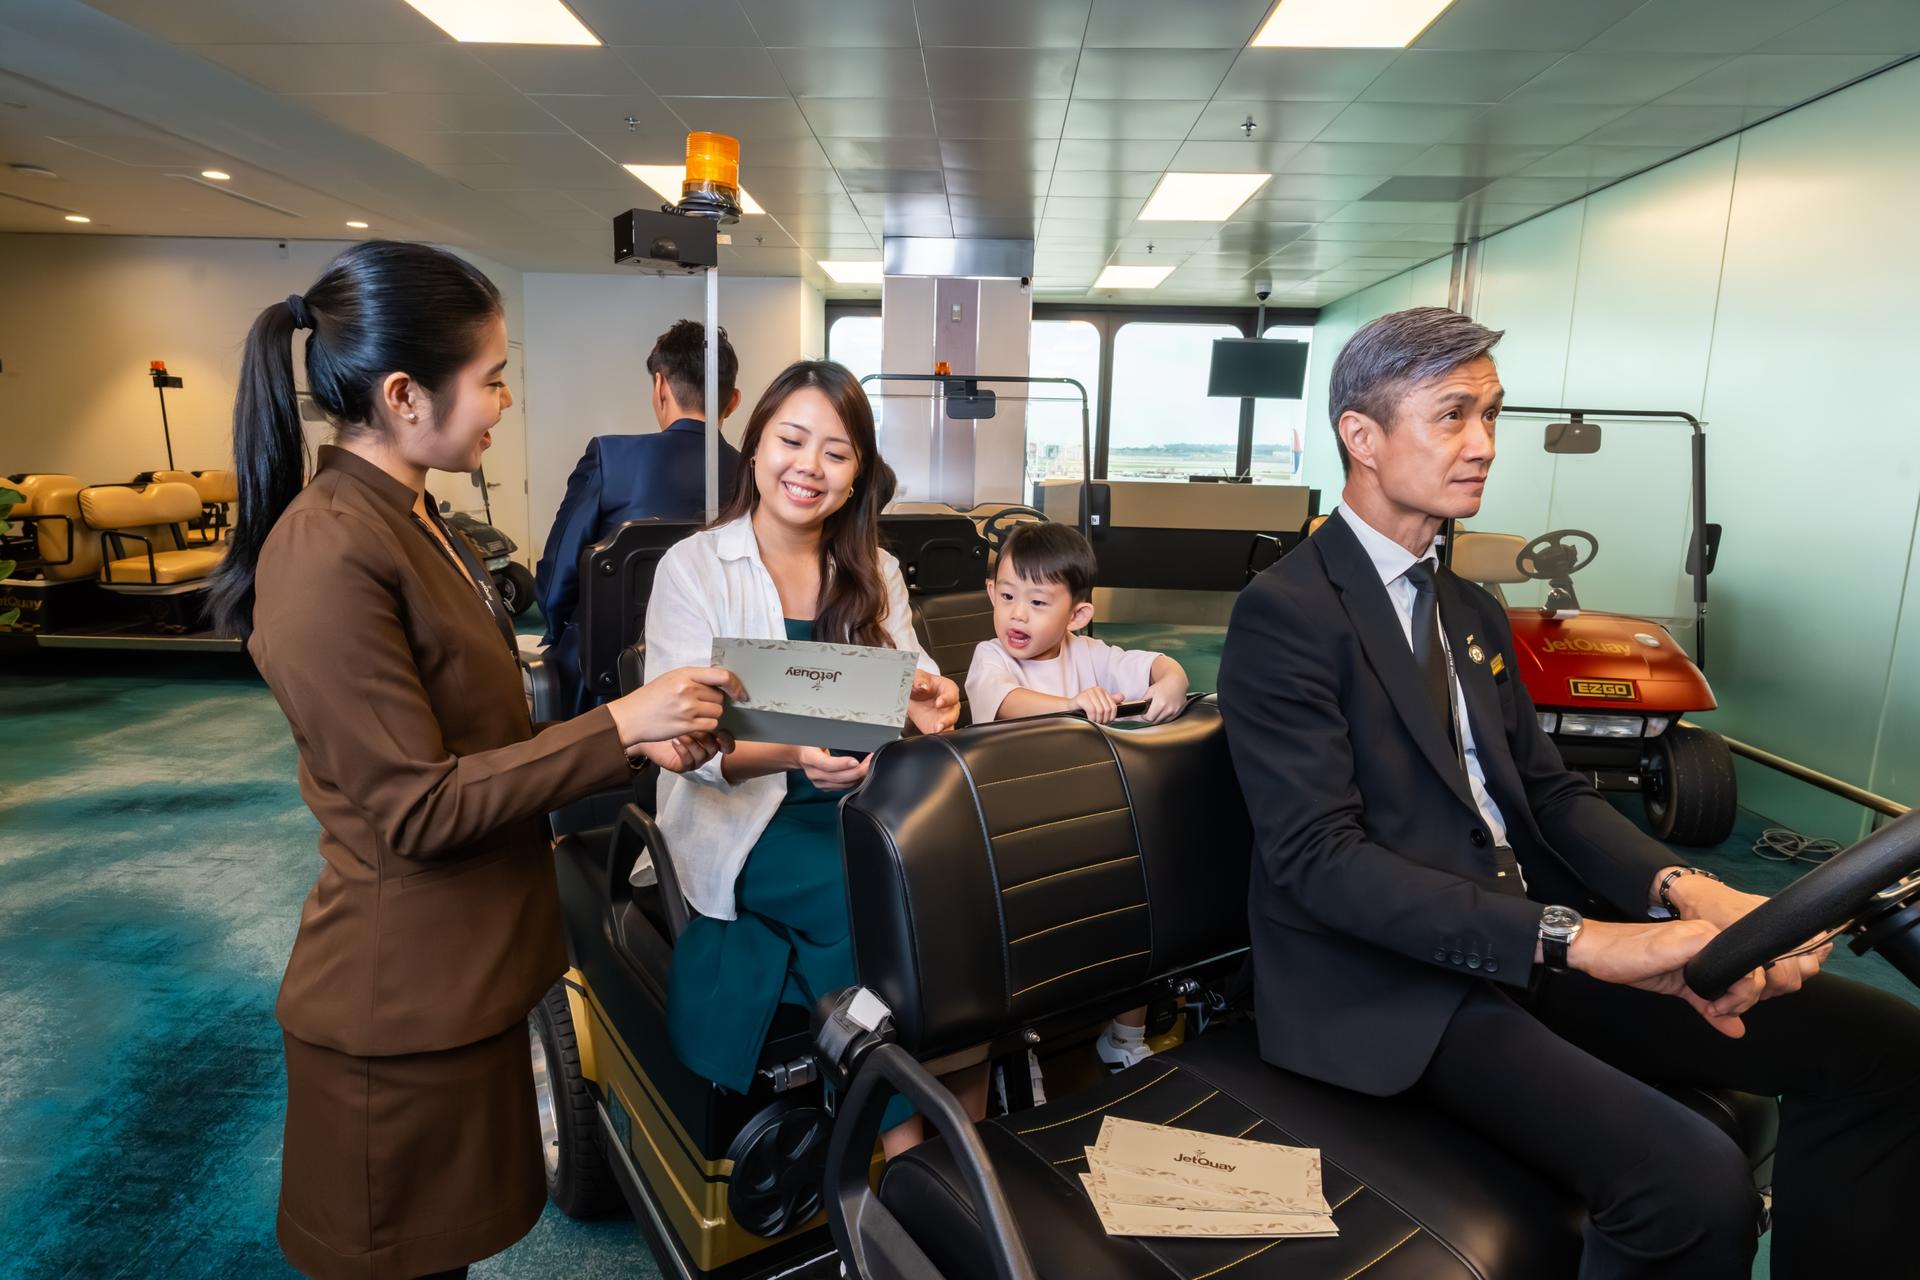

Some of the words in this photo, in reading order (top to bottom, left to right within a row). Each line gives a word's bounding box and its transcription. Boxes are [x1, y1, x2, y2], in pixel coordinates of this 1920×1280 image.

[1542, 637, 1631, 656] JetQuay
[785, 666, 843, 683] JetQuay
[1173, 1153, 1237, 1173] JetQuay
